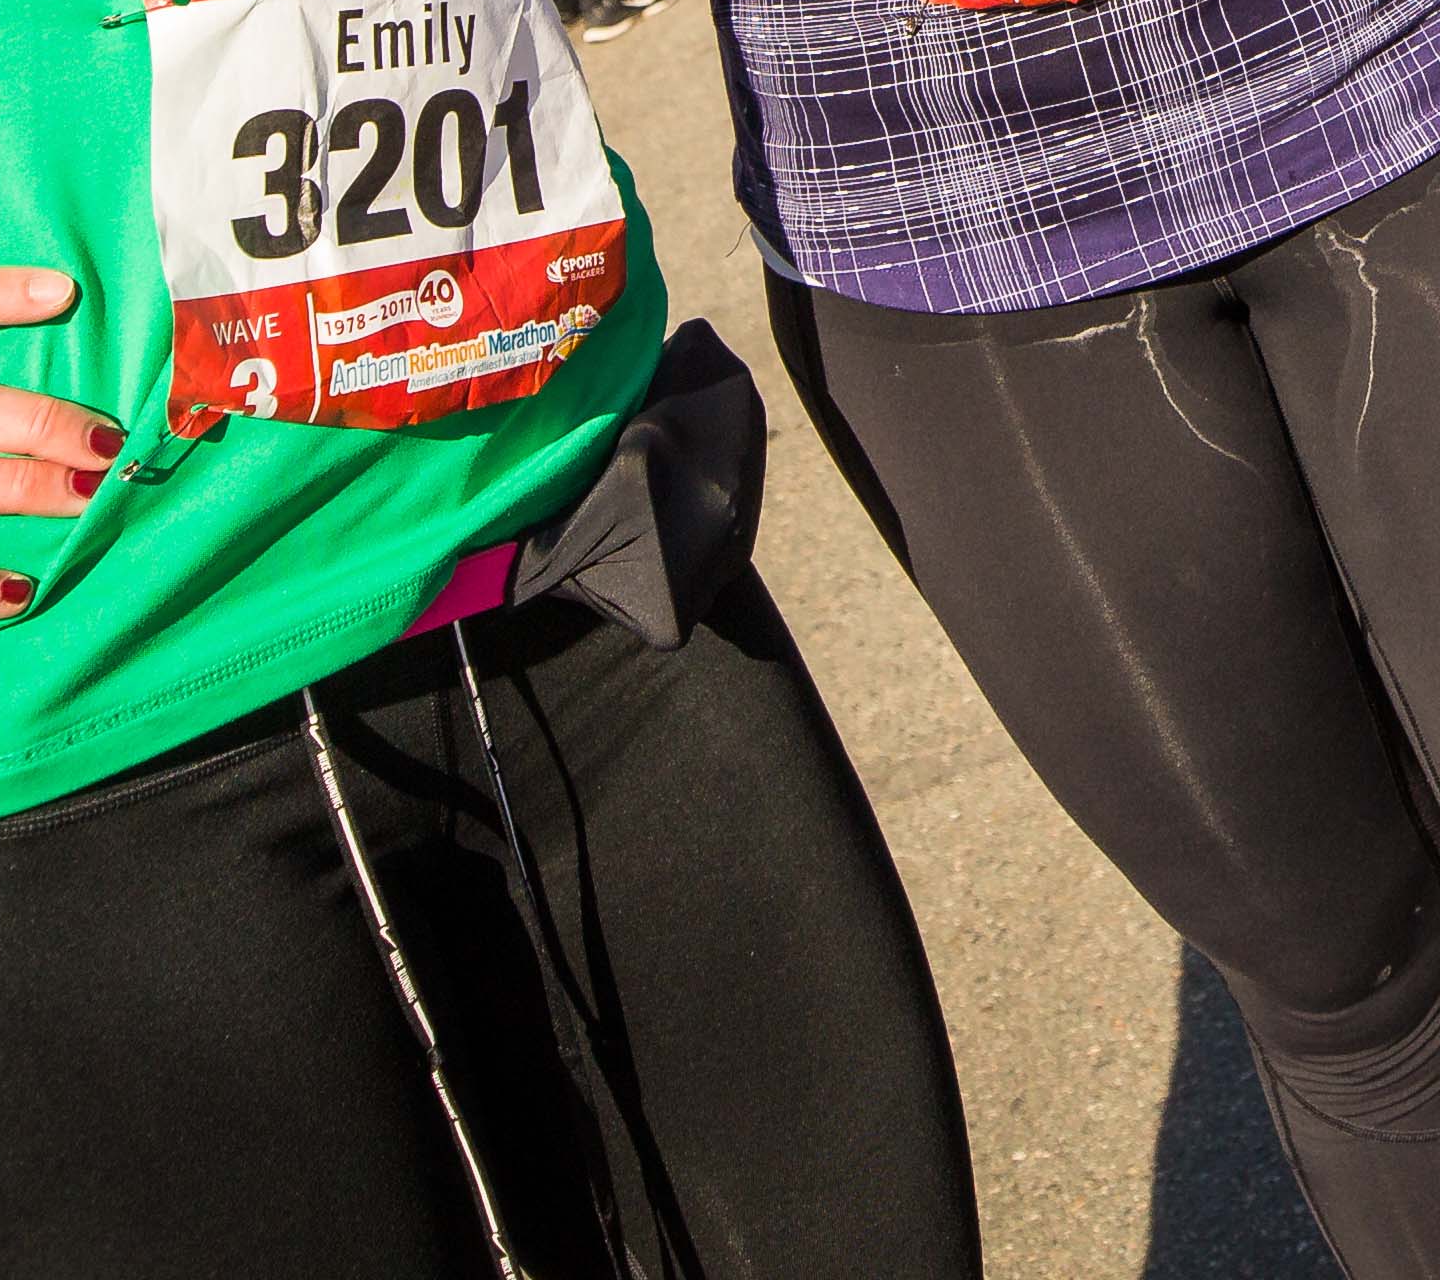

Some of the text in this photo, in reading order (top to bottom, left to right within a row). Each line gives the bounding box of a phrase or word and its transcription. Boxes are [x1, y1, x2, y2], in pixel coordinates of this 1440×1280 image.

[337, 1, 476, 76] Emily
[231, 80, 545, 260] 3201
[562, 252, 605, 272] SPORTS
[570, 266, 606, 281] BACKERS
[420, 277, 454, 306] 40
[212, 312, 282, 347] WAVE
[333, 322, 556, 389] Anthem Richmond Marathon
[230, 358, 278, 419] 3
[317, 750, 344, 809] NIKE RUNNING
[390, 949, 418, 1004] NIKE RUNNING
